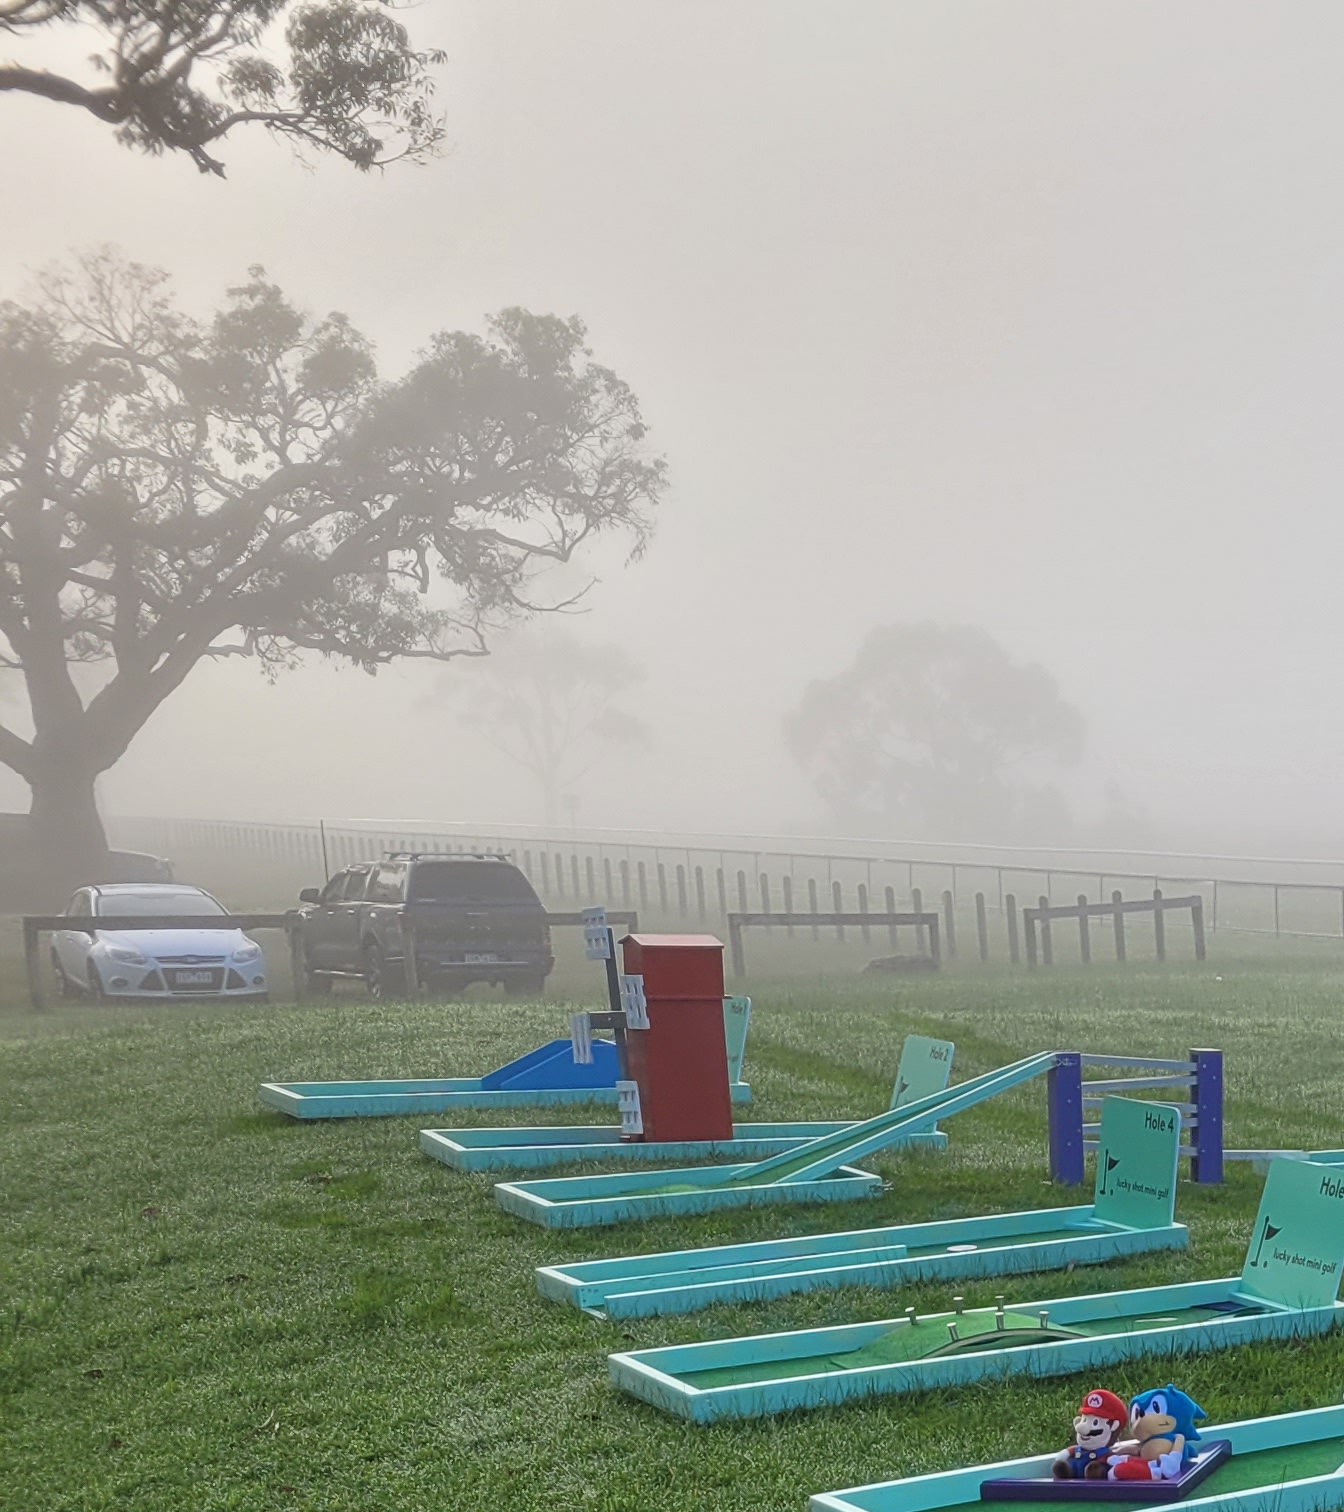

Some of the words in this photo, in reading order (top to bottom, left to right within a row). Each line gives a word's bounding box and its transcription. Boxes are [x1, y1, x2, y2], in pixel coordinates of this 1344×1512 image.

[1145, 1111, 1166, 1132] Hole
[1168, 1117, 1174, 1133] 4
[1116, 1178, 1131, 1192] lucky
[1132, 1181, 1144, 1193] shot
[1145, 1186, 1157, 1196] mini
[1157, 1188, 1169, 1200] golf
[1273, 1247, 1291, 1265] lucky
[1291, 1252, 1306, 1267] shot
[1306, 1258, 1322, 1270] mini
[1321, 1262, 1338, 1275] golf
[1089, 1396, 1100, 1405] M
